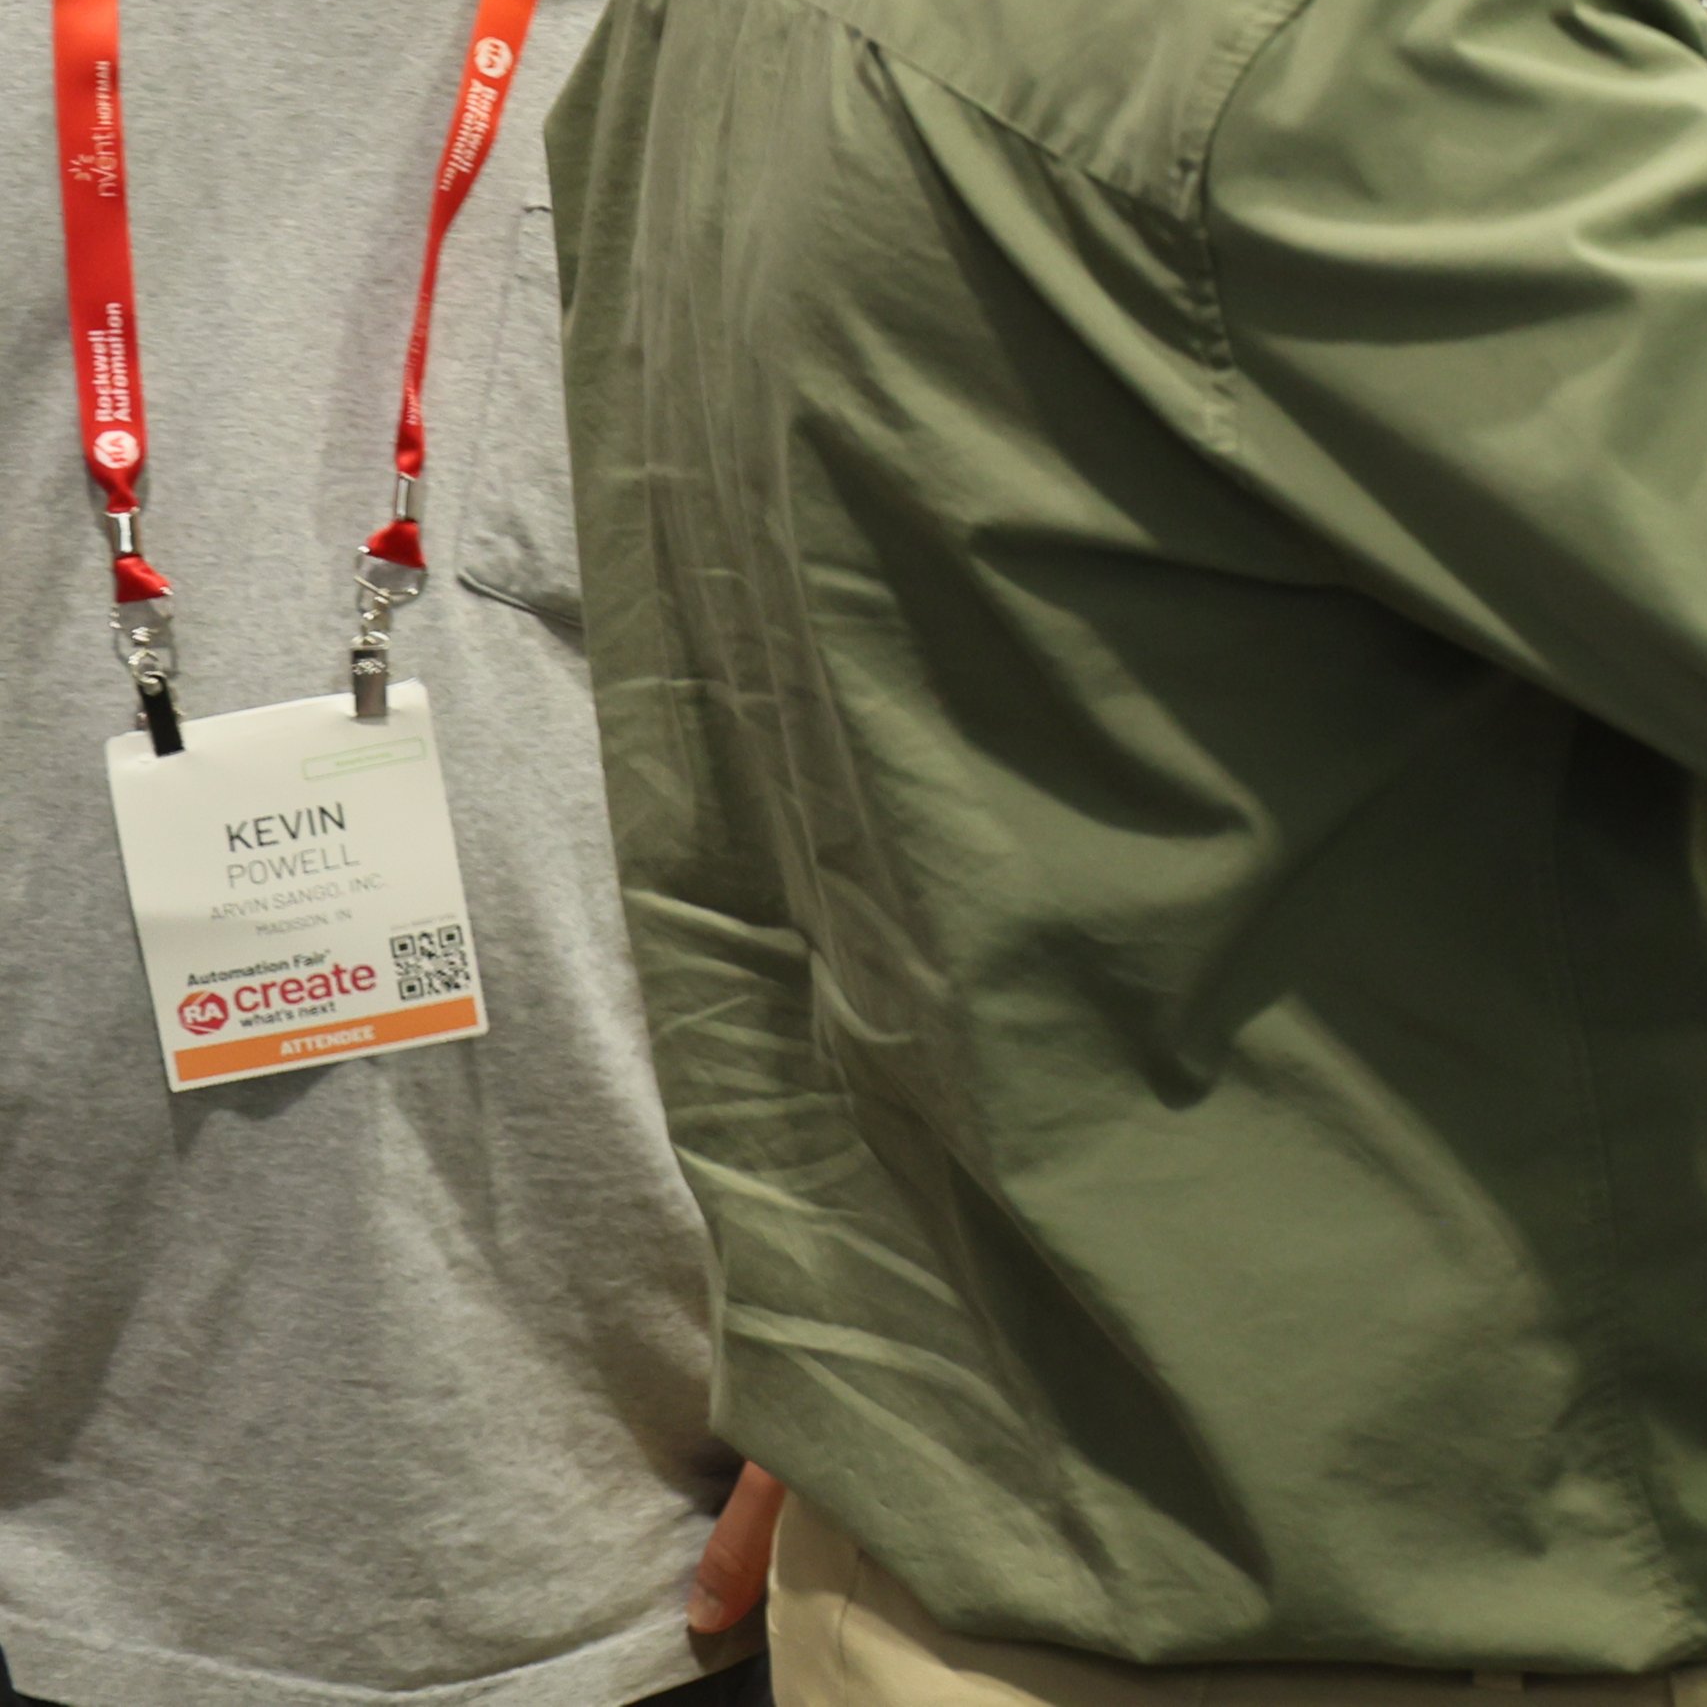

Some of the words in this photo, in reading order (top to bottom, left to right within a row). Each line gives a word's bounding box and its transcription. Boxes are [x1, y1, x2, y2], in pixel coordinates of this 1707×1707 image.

[87, 329, 114, 422] Rockwell
[105, 302, 132, 422] Automation
[225, 801, 346, 853] KEVIN
[226, 844, 361, 890] POWELL
[186, 959, 290, 987] Automation
[233, 963, 377, 1014] create
[239, 1006, 294, 1029] what's
[298, 1000, 337, 1018] next
[279, 1025, 377, 1058] ATTENDEE
